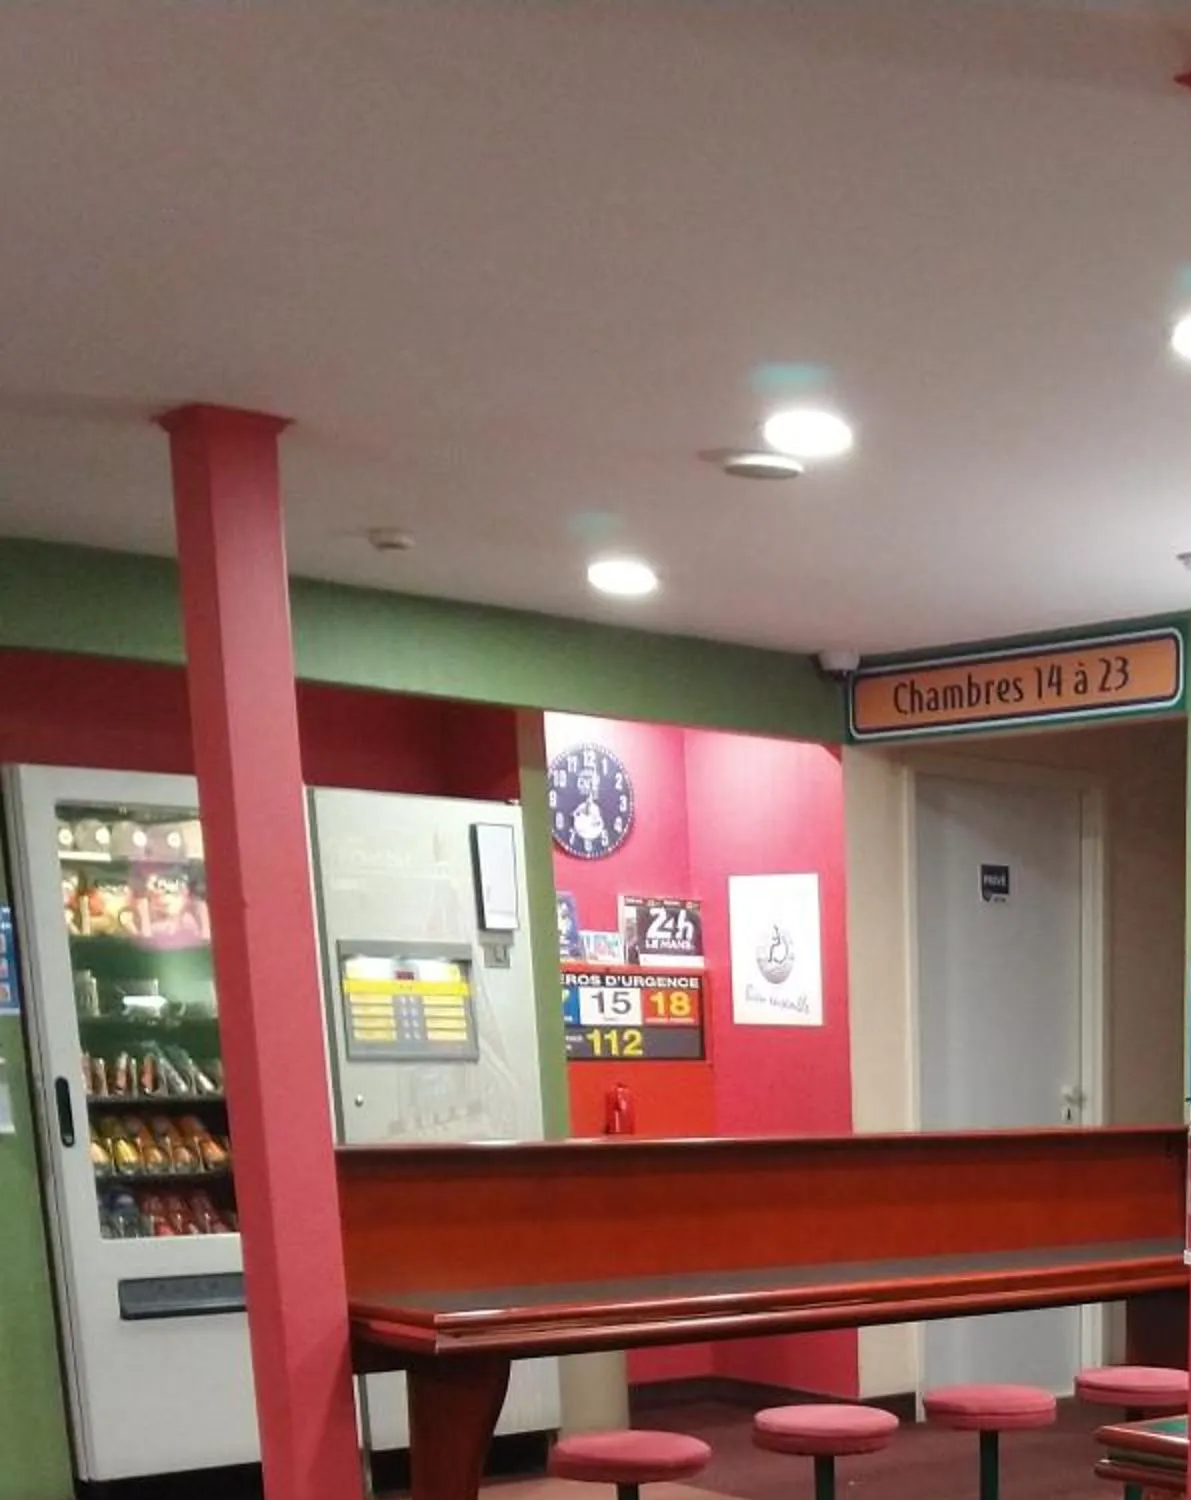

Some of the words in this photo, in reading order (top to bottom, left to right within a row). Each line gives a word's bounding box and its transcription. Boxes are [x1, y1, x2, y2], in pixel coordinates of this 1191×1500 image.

[892, 673, 1024, 716] Chambres
[1034, 664, 1063, 699] 14
[1073, 662, 1089, 696] à
[1098, 656, 1131, 693] 23
[615, 772, 623, 790] 2
[619, 795, 628, 812] 3
[645, 906, 695, 940] 24h
[561, 973, 601, 985] ROS
[605, 975, 700, 989] D'URGENCE
[591, 990, 632, 1015] 15
[650, 990, 692, 1017] 18
[585, 1028, 644, 1056] 112
